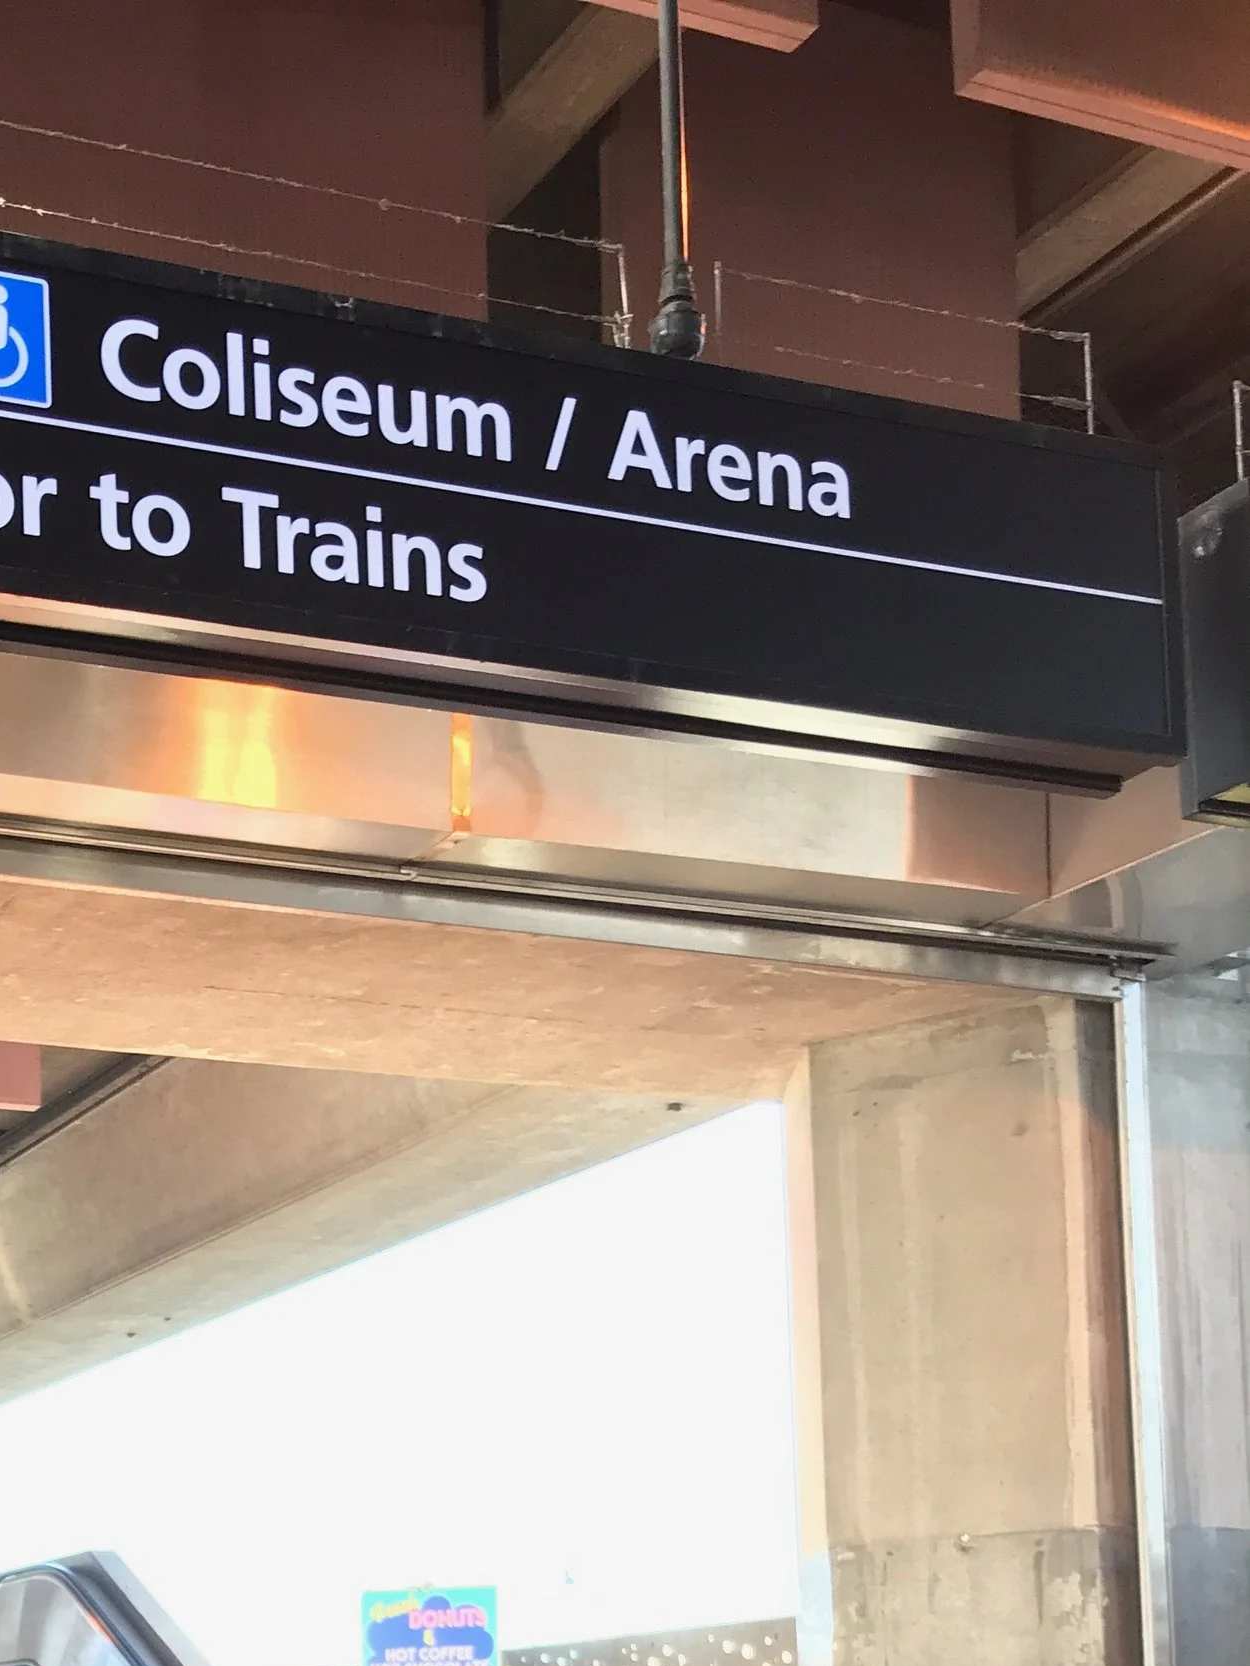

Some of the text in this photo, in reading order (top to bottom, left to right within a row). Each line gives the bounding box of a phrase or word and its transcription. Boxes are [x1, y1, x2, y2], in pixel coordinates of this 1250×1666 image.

[100, 319, 512, 462] Coliseum
[608, 409, 851, 519] Arena
[89, 473, 191, 557] to
[221, 486, 488, 602] Trains
[385, 1645, 474, 1662] HOT COFFEE
[408, 1607, 487, 1629] DONUTS
